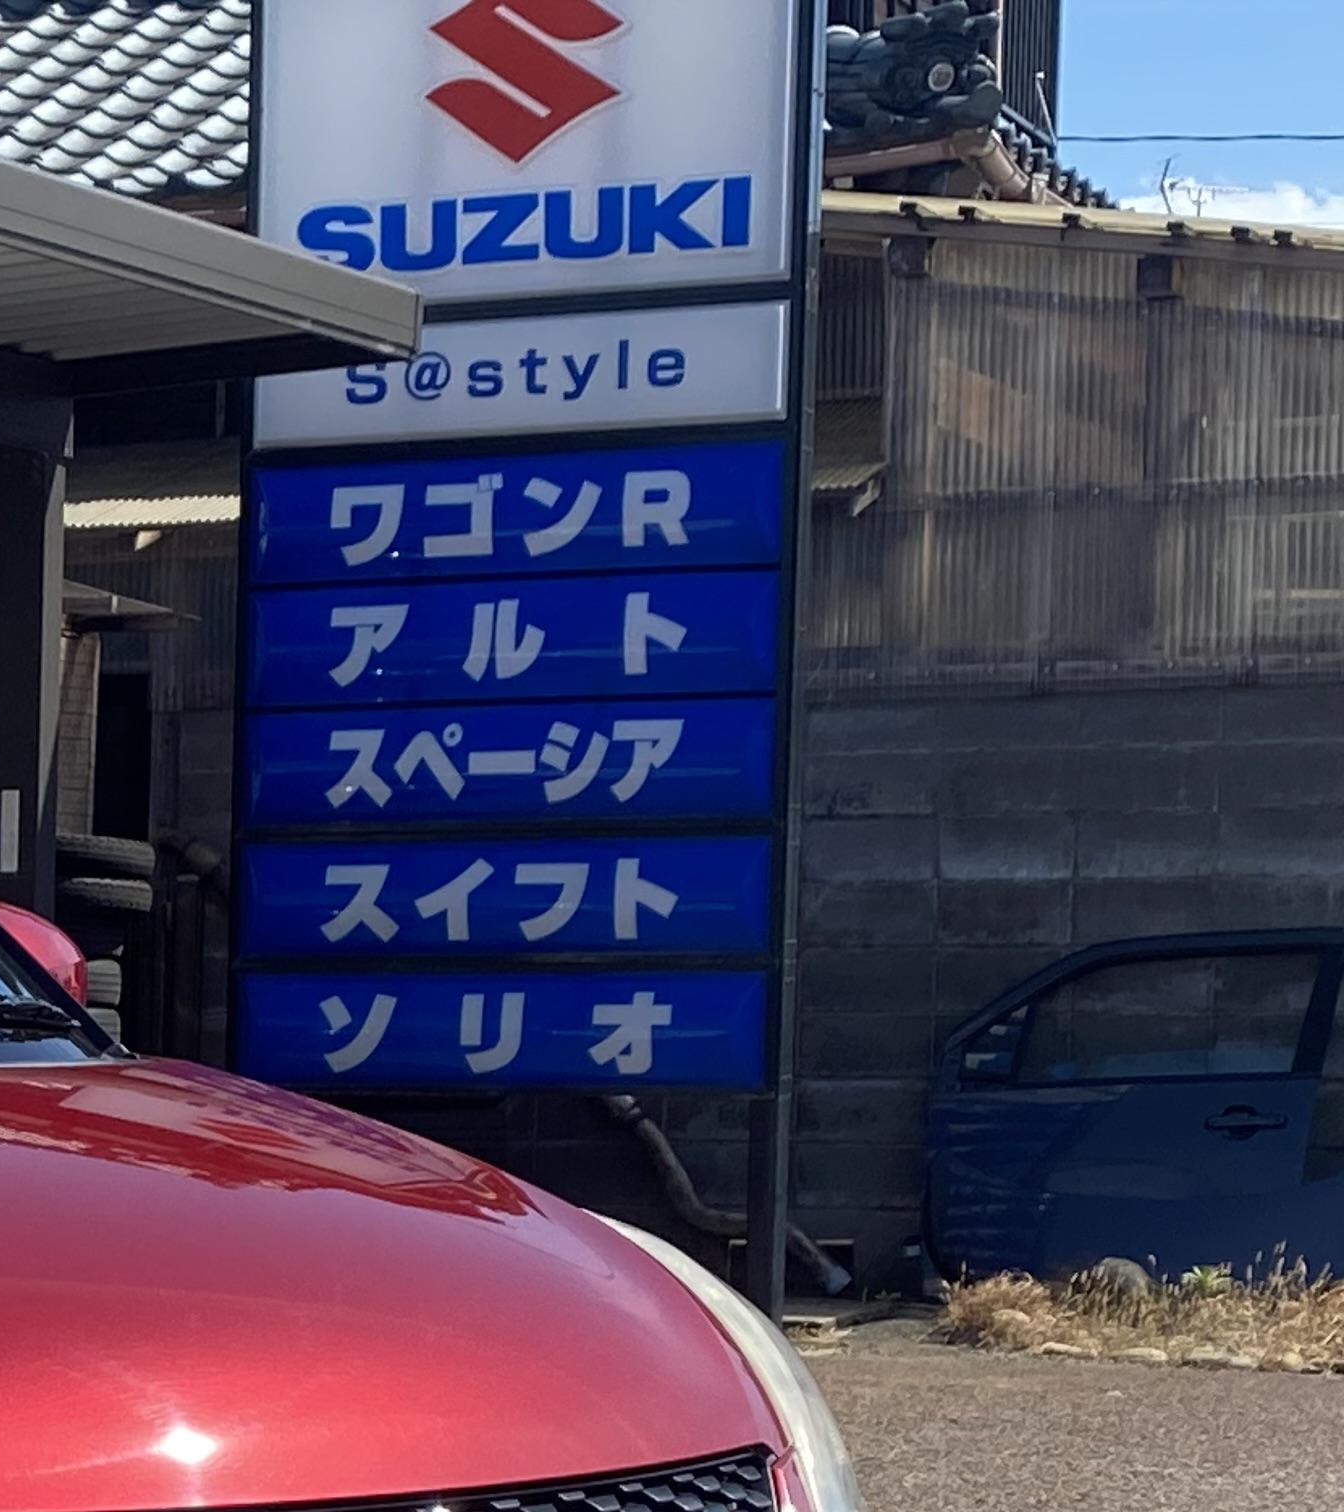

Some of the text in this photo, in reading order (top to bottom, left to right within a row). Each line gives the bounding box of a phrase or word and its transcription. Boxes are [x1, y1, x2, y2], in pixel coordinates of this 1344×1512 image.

[296, 175, 752, 272] SUZUKI
[344, 339, 686, 405] S@style
[329, 470, 692, 567] ワゴンR
[328, 591, 688, 688] アルト
[324, 719, 685, 809] スペーシア
[319, 857, 680, 942] スイフト
[318, 991, 673, 1076] ソリオ
